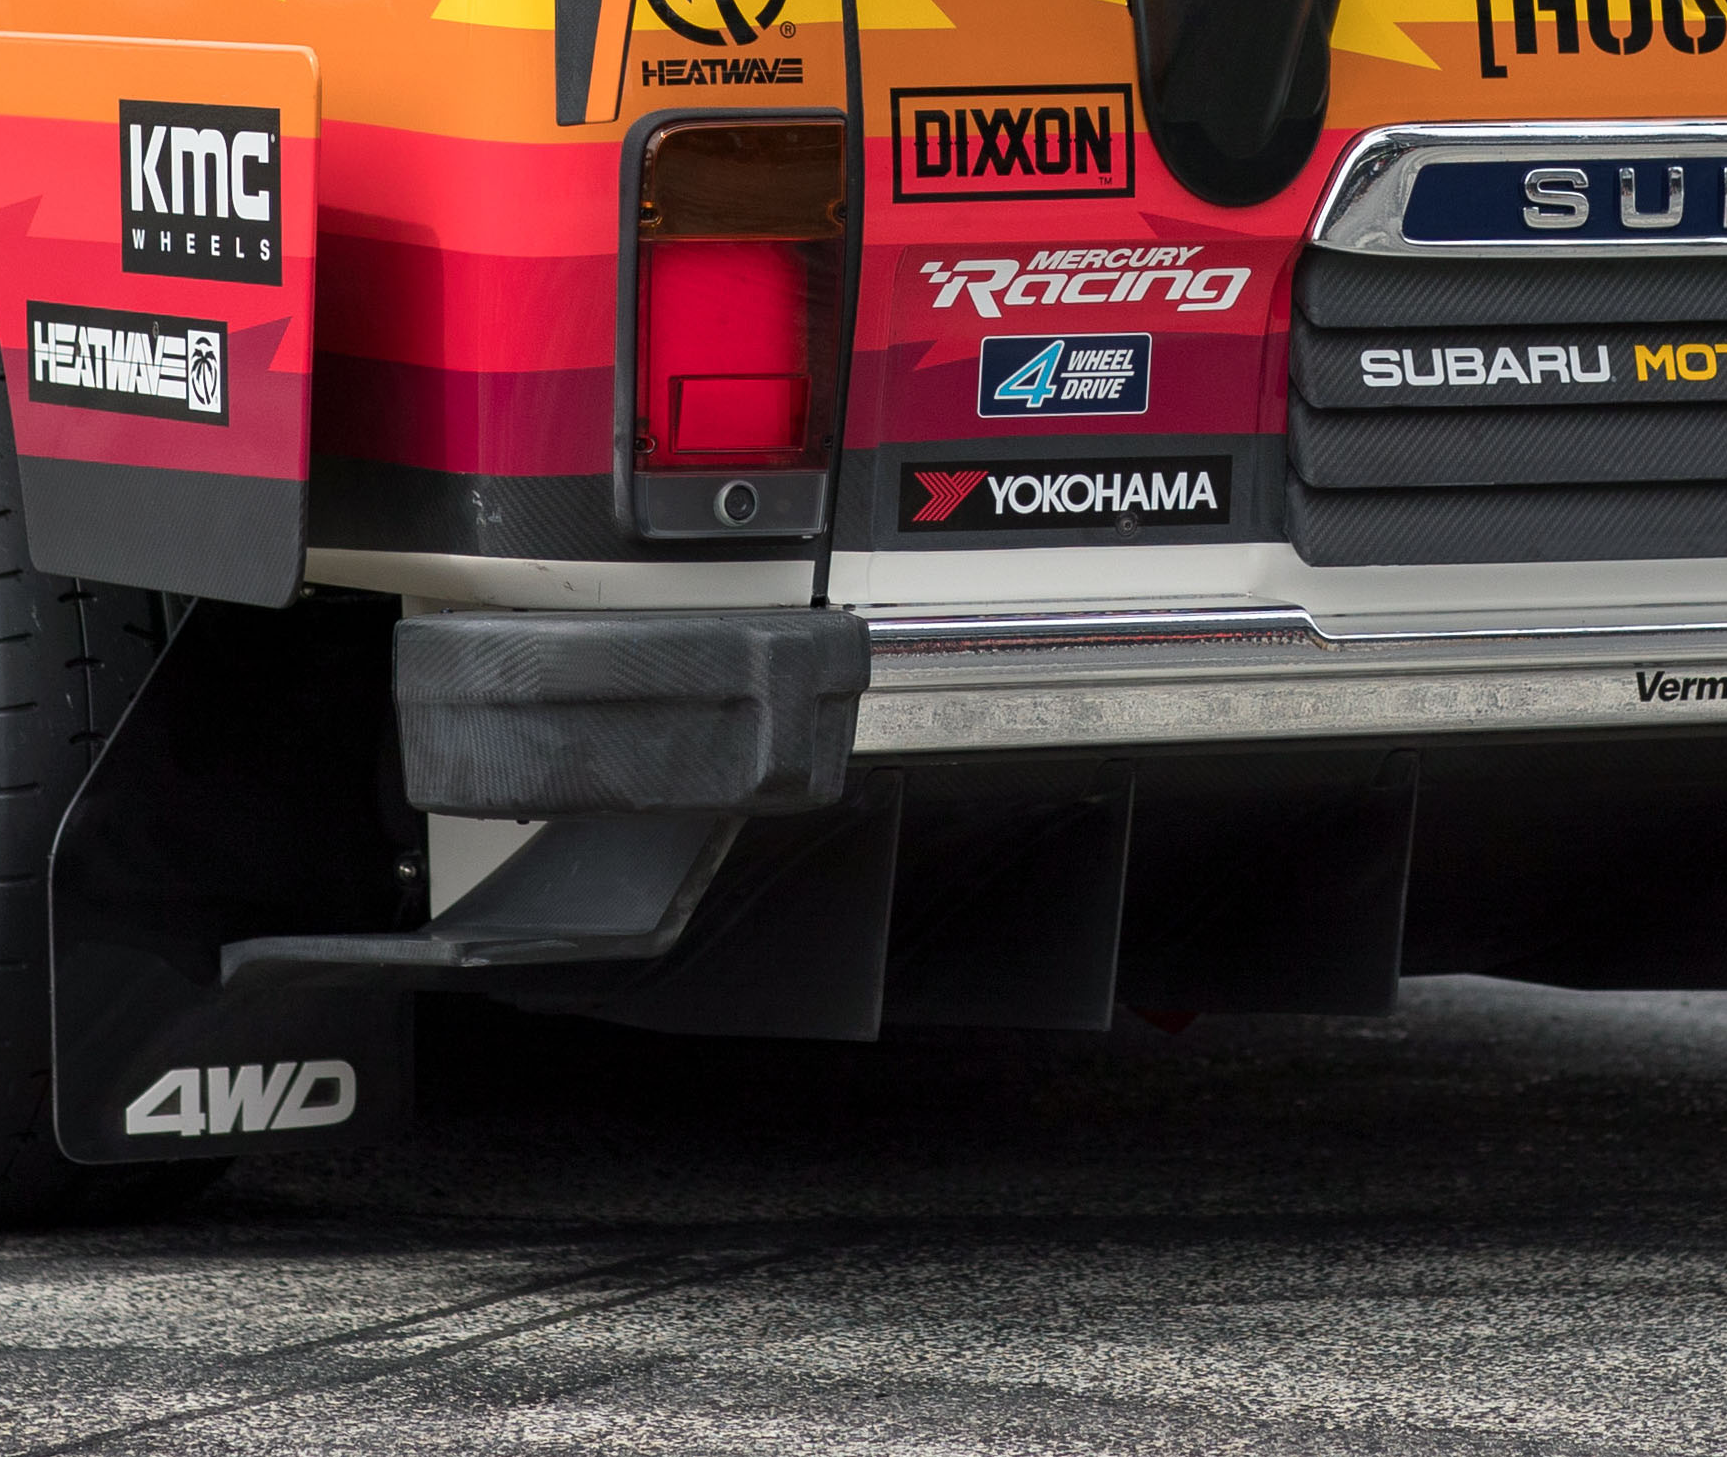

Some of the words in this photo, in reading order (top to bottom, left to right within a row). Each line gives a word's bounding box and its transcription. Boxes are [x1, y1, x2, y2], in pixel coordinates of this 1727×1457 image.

[642, 57, 803, 86] HEATWAVE
[914, 105, 1112, 179] DIXXON
[130, 123, 270, 221] KMC
[132, 228, 271, 261] WHEELS
[1027, 246, 1204, 271] MERCURY
[920, 259, 1252, 318] Racing
[33, 320, 187, 400] HEATWAVE
[993, 340, 1064, 407] 4
[1068, 349, 1134, 372] WHEEL
[1359, 346, 1612, 387] SUBARU
[1060, 378, 1125, 400] DRIVE
[987, 472, 1218, 514] YOKOHAMA
[126, 1061, 356, 1137] 4WD
